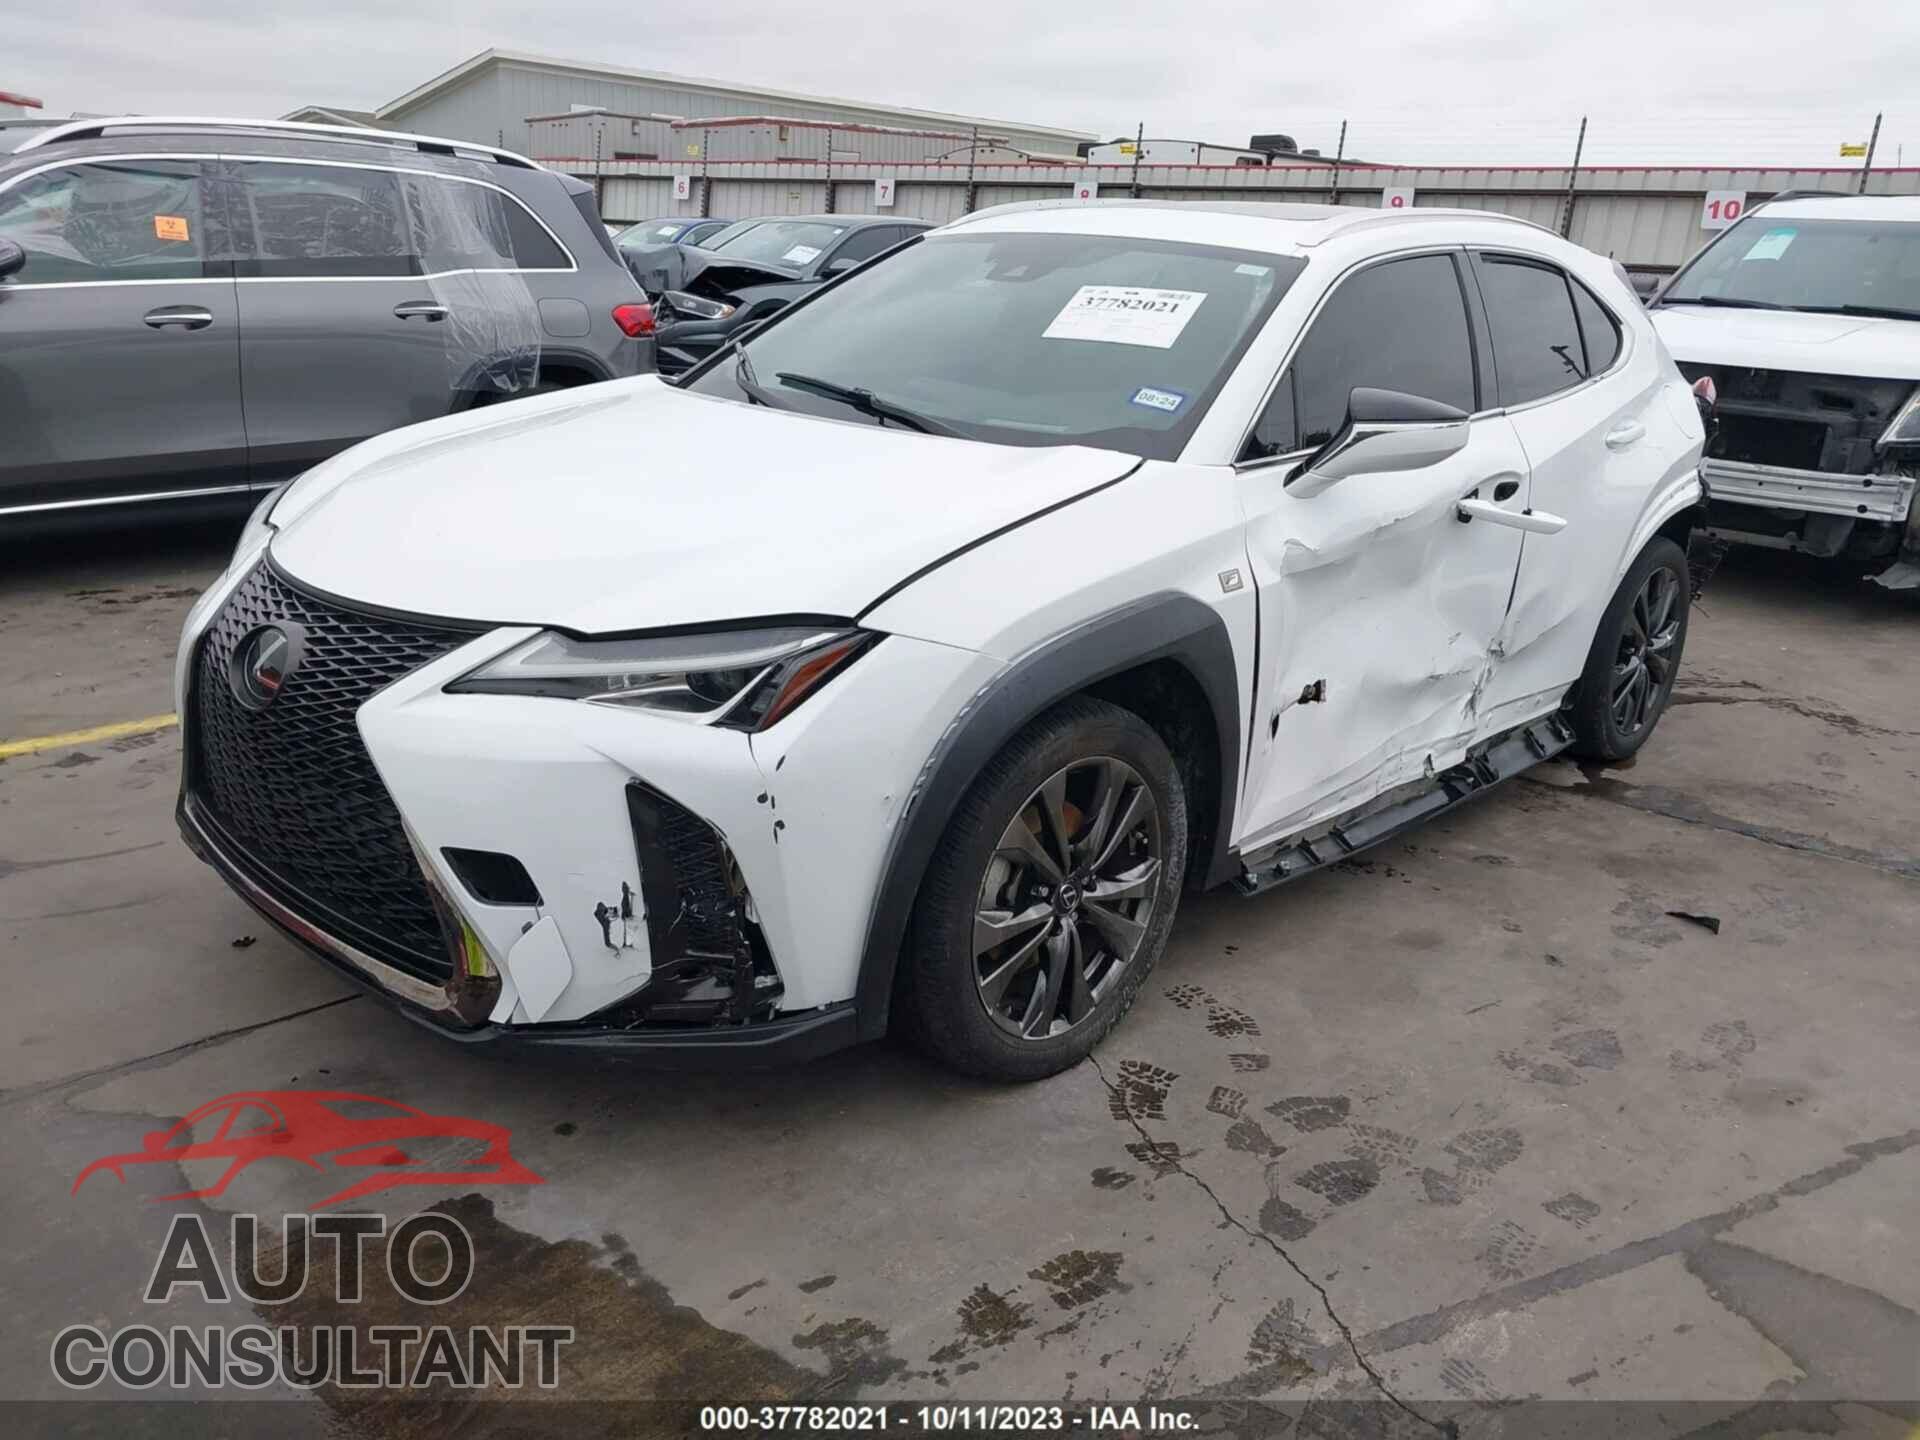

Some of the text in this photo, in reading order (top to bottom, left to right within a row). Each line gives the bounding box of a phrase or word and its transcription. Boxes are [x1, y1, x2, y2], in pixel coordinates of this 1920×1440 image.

[678, 182, 685, 194] 6
[880, 185, 889, 199] 7
[1707, 200, 1741, 220] 10
[1080, 296, 1181, 313] 37782021
